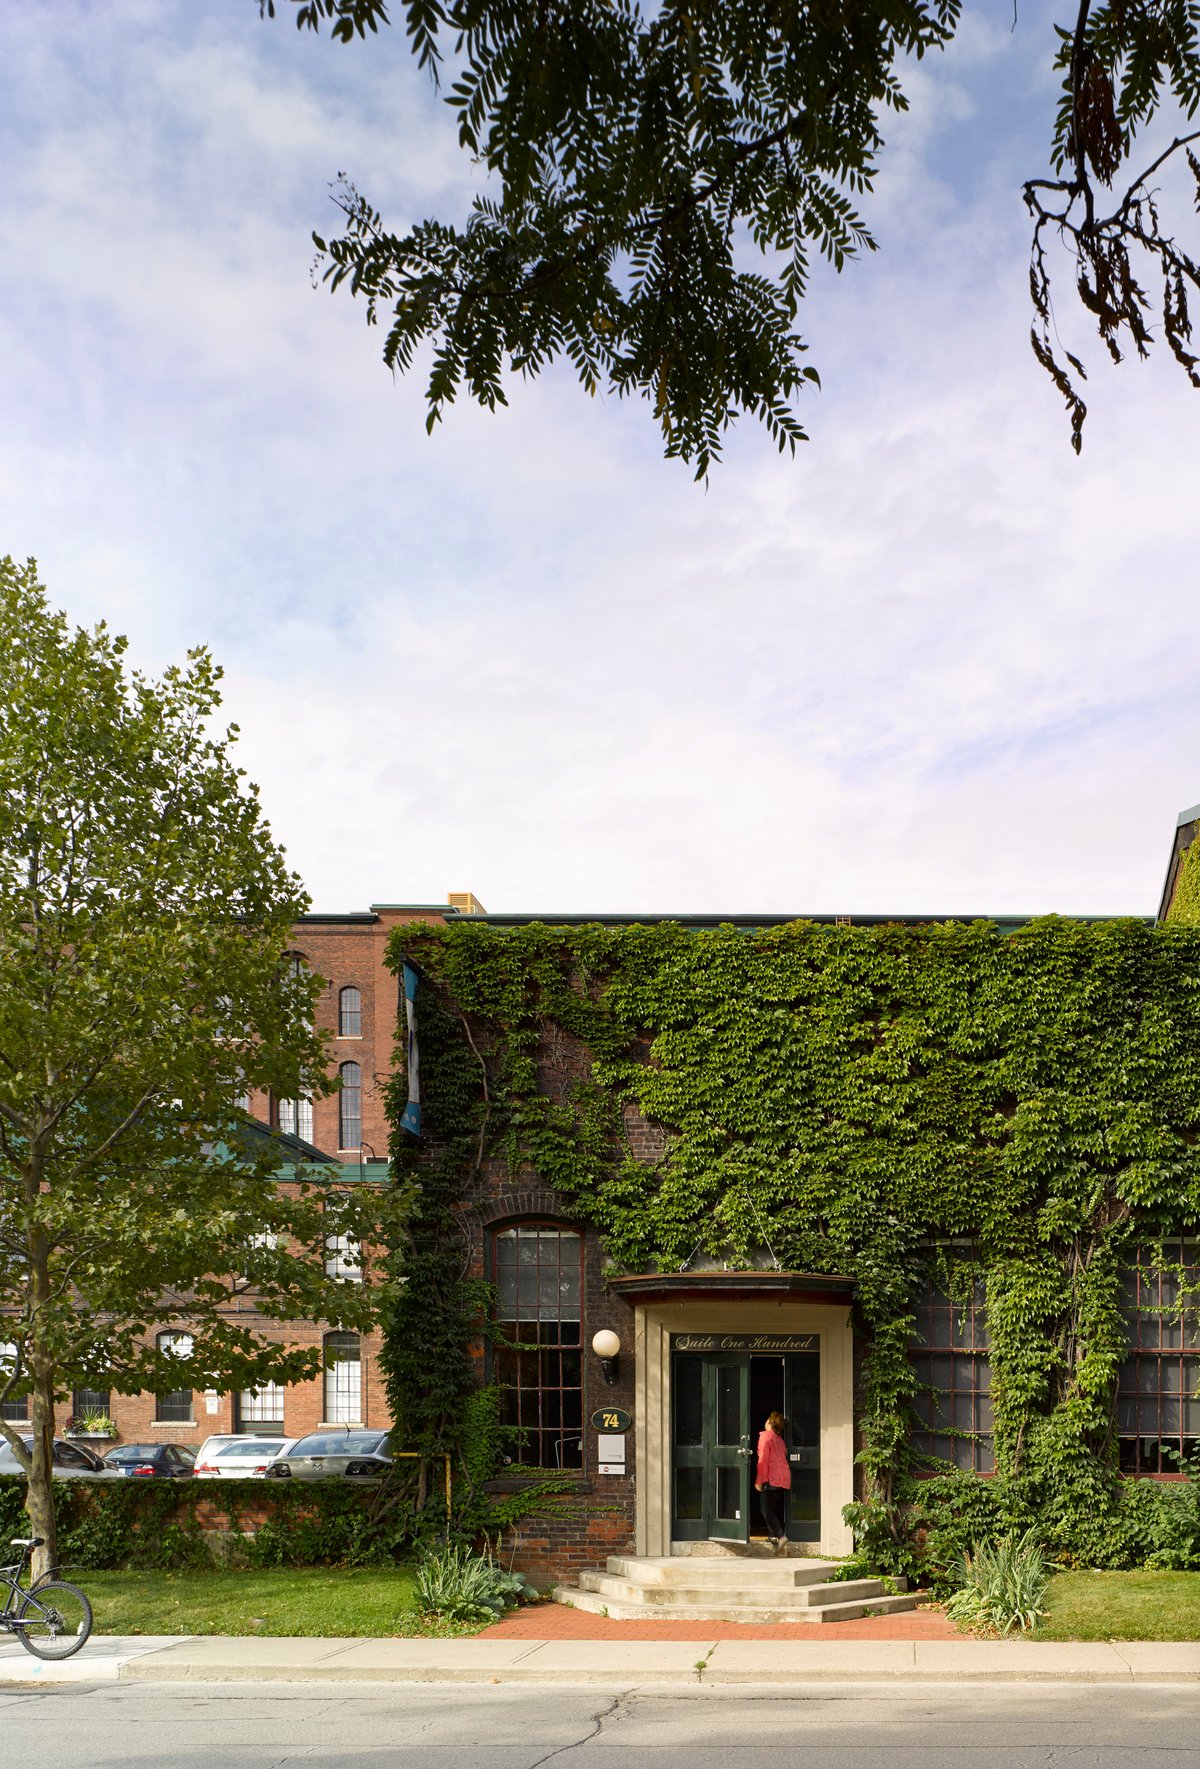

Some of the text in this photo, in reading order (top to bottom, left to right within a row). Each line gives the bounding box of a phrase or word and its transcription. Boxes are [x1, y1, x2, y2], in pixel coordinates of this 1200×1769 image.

[675, 1335, 813, 1349] Suite One Hundred
[602, 1413, 619, 1428] 74
